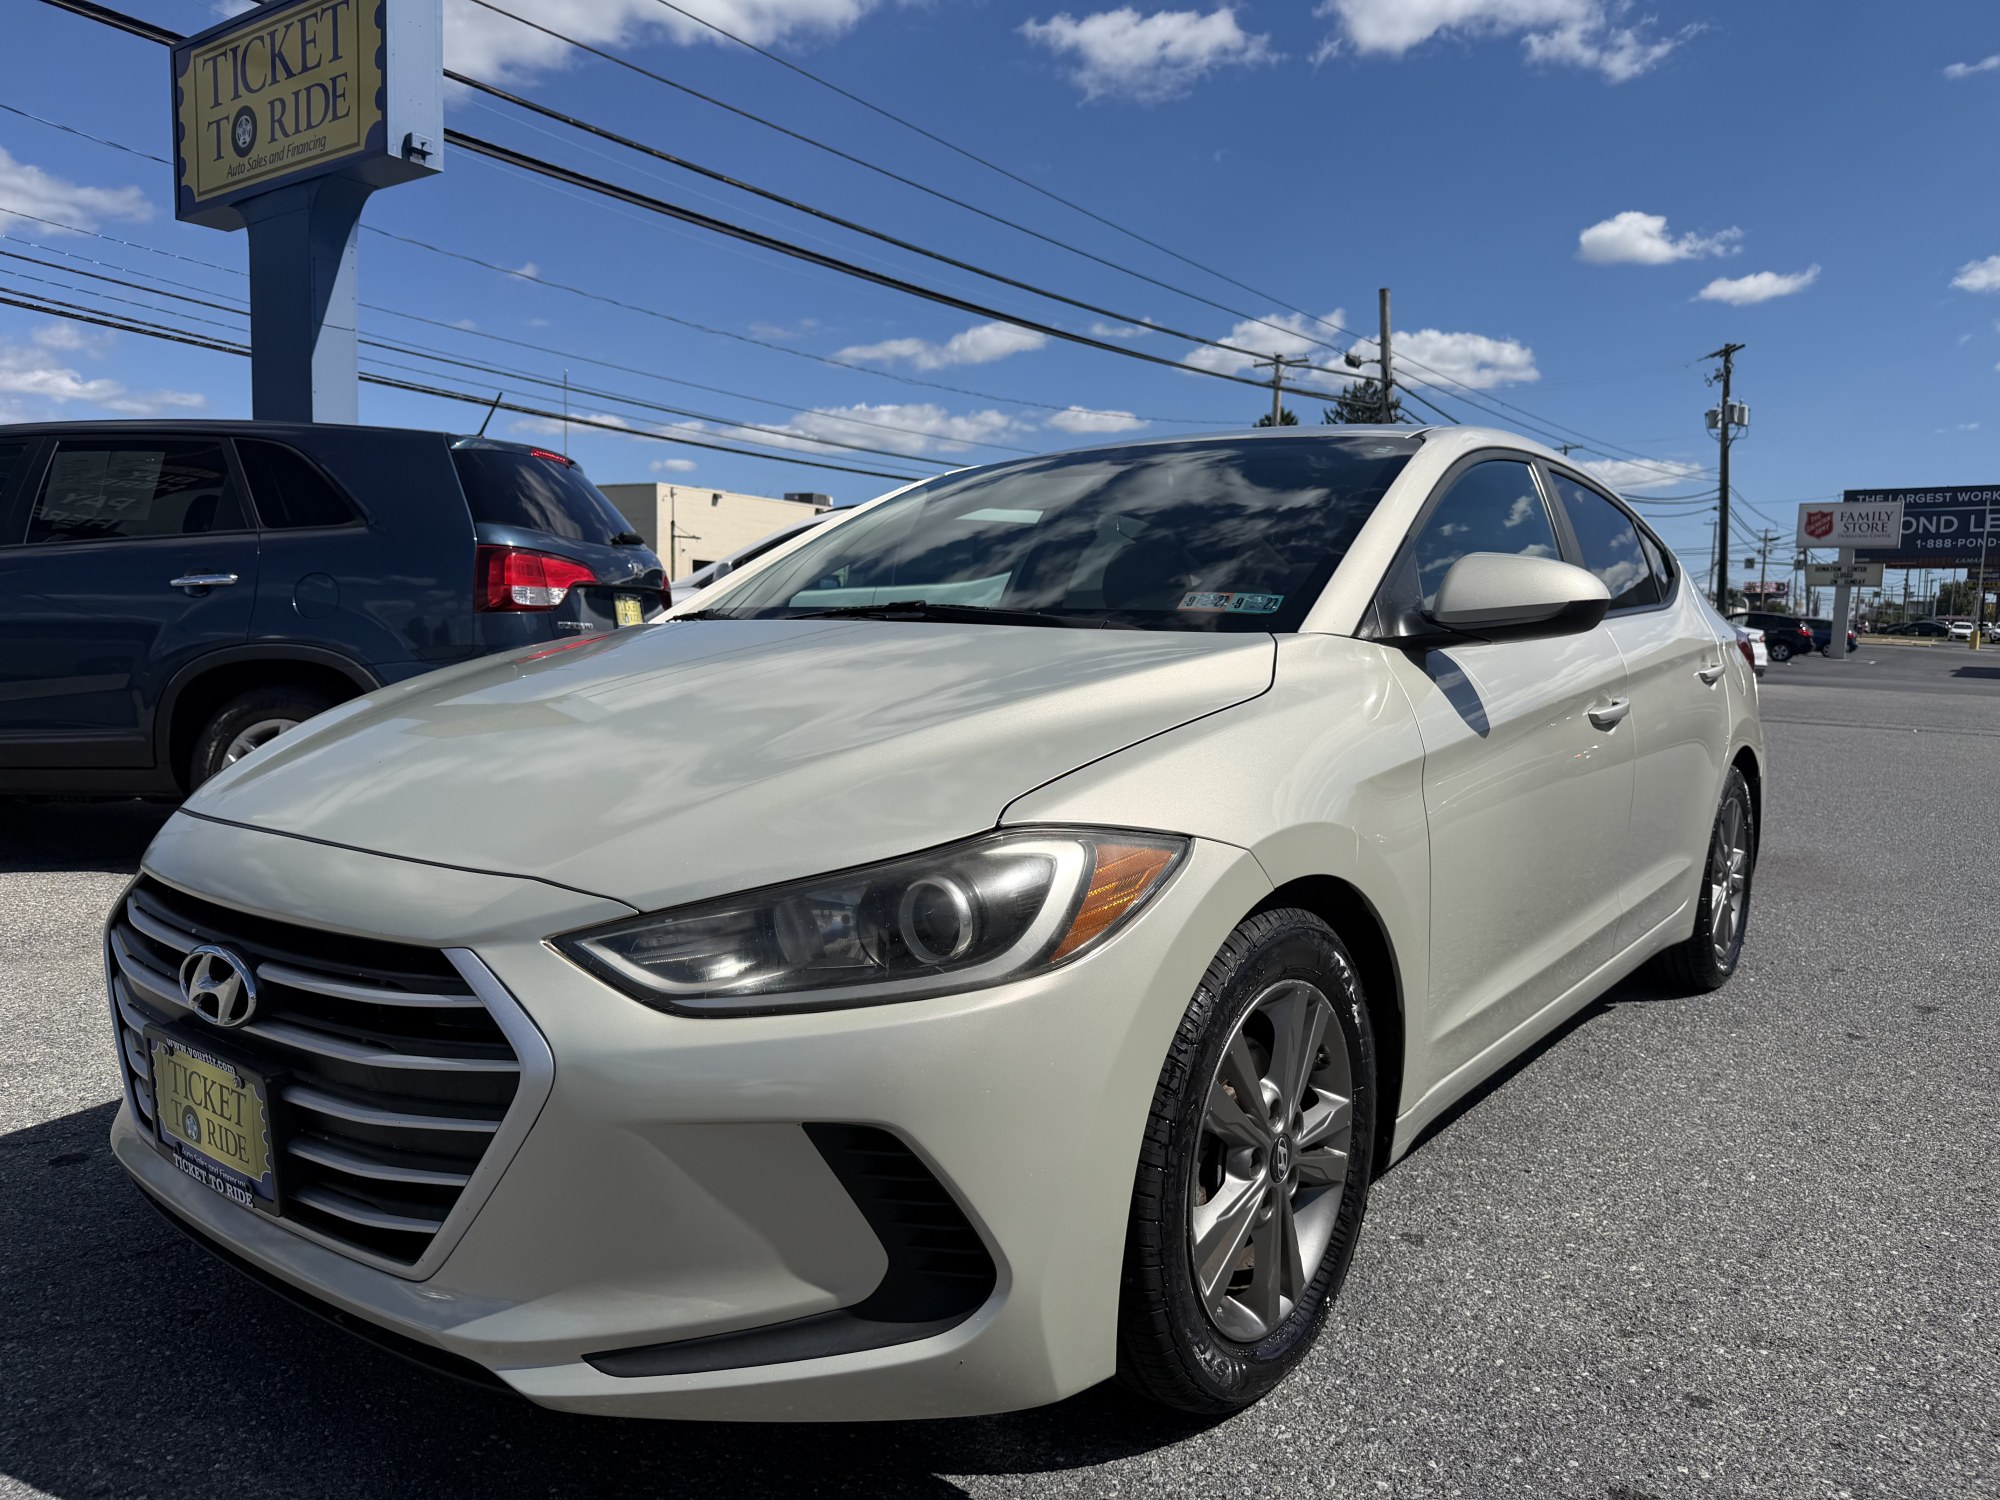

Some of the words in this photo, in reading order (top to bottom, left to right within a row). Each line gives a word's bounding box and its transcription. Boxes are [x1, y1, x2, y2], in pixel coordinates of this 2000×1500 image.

[202, 2, 350, 110] TICKET
[267, 72, 351, 145] RIDE
[226, 163, 246, 179] Auto
[246, 154, 268, 173] Sales
[269, 148, 286, 164] and
[286, 134, 327, 158] Financing
[1840, 511, 1894, 522] FAMILY
[1843, 522, 1888, 533] STORE
[168, 1059, 247, 1128] TICKET
[205, 1117, 250, 1165] RIDE
[173, 1152, 207, 1184] TICKET
[208, 1174, 225, 1195] TO
[226, 1185, 254, 1208] RIDE
